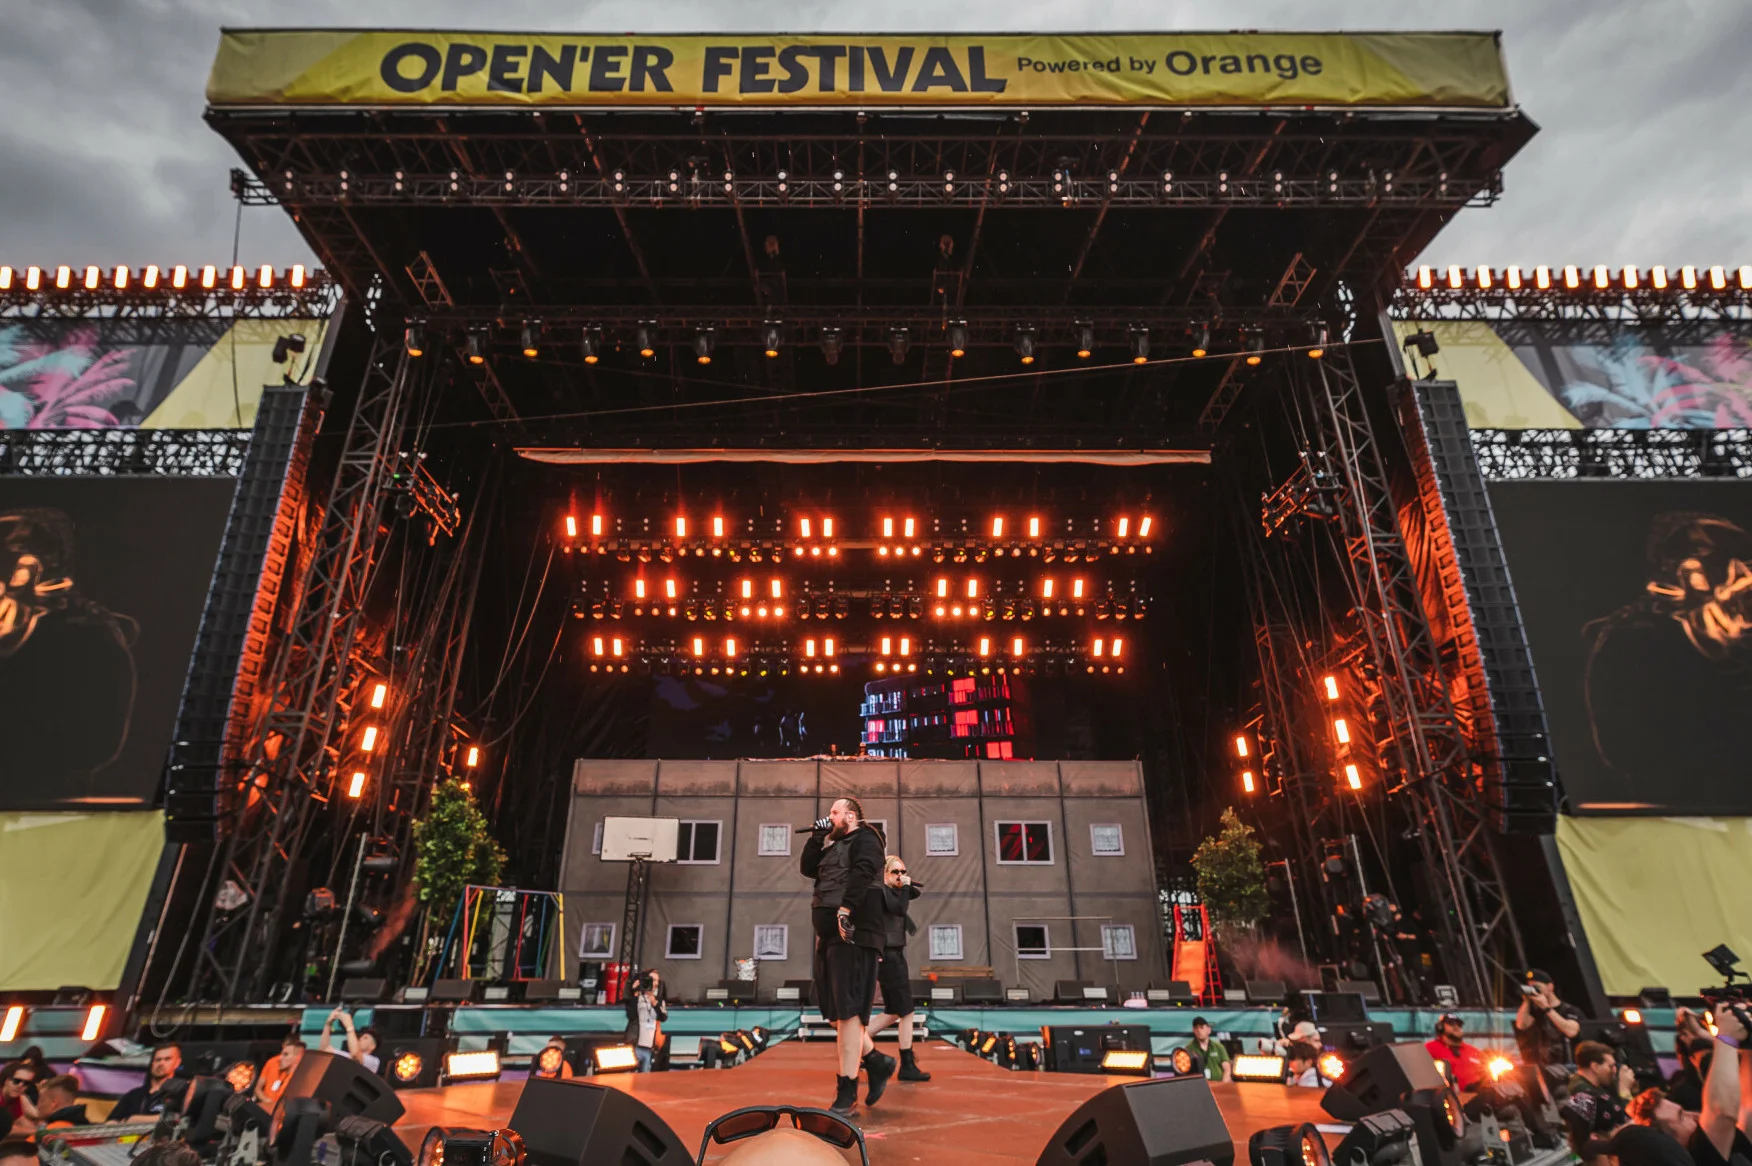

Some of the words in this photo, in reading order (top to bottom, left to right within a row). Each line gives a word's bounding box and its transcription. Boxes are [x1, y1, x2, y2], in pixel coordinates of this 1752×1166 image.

[380, 43, 674, 92] OPEN'ER
[702, 45, 1008, 93] FESTIVAL
[1017, 55, 1122, 73] Powered
[1130, 57, 1156, 75] by
[1165, 50, 1322, 79] Orange
